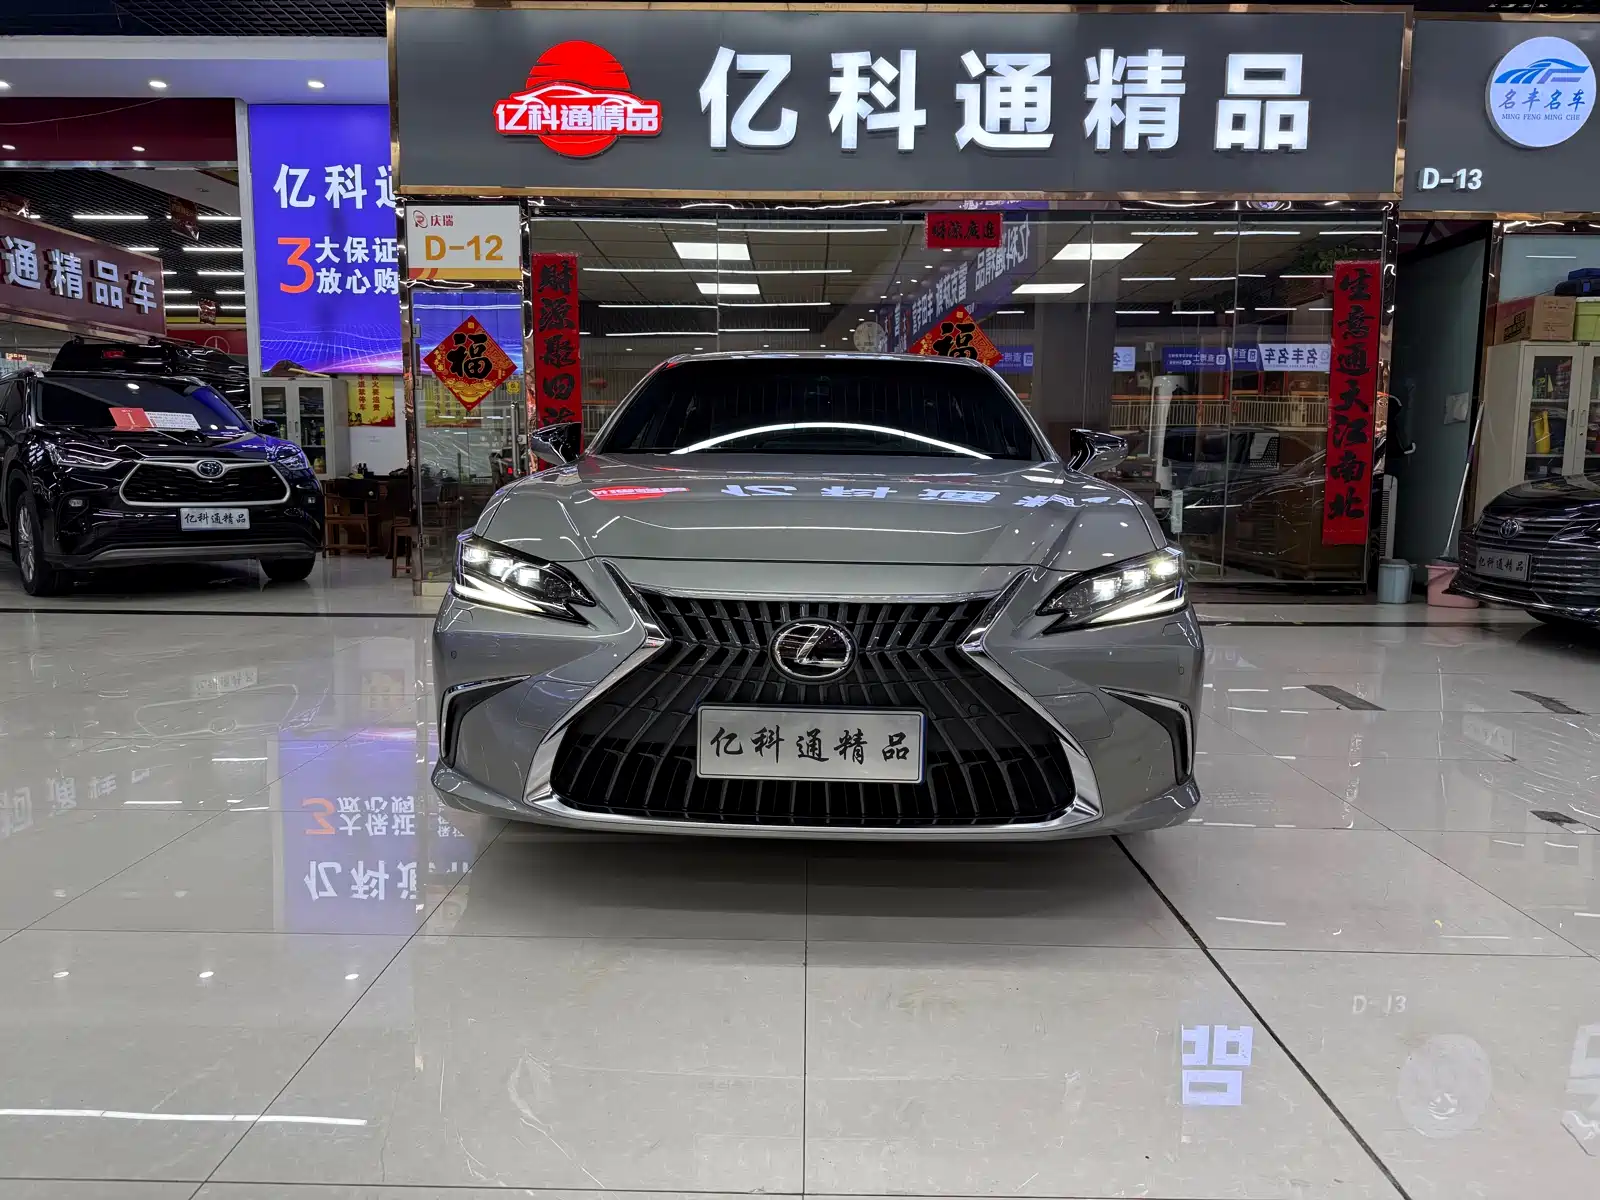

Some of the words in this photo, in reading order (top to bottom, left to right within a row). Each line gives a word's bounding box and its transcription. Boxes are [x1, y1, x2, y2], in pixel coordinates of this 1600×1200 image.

[699, 46, 1310, 151] 亿科通精品
[1498, 88, 1586, 112] 名丰名车
[496, 103, 658, 131] 亿科通精品
[1501, 113, 1520, 121] MING
[1523, 113, 1541, 121] FENG
[1544, 113, 1563, 121] MING
[1420, 168, 1482, 190] D-13
[430, 214, 454, 227] 庆瑞
[425, 234, 503, 261] D-12
[1, 234, 158, 316] 通精品车
[277, 237, 315, 294] 3
[315, 236, 398, 265] 大保证
[316, 267, 398, 296] 放心购
[447, 333, 493, 380] 福
[184, 511, 246, 525] 亿科通精品
[709, 724, 911, 765] 亿科通精品
